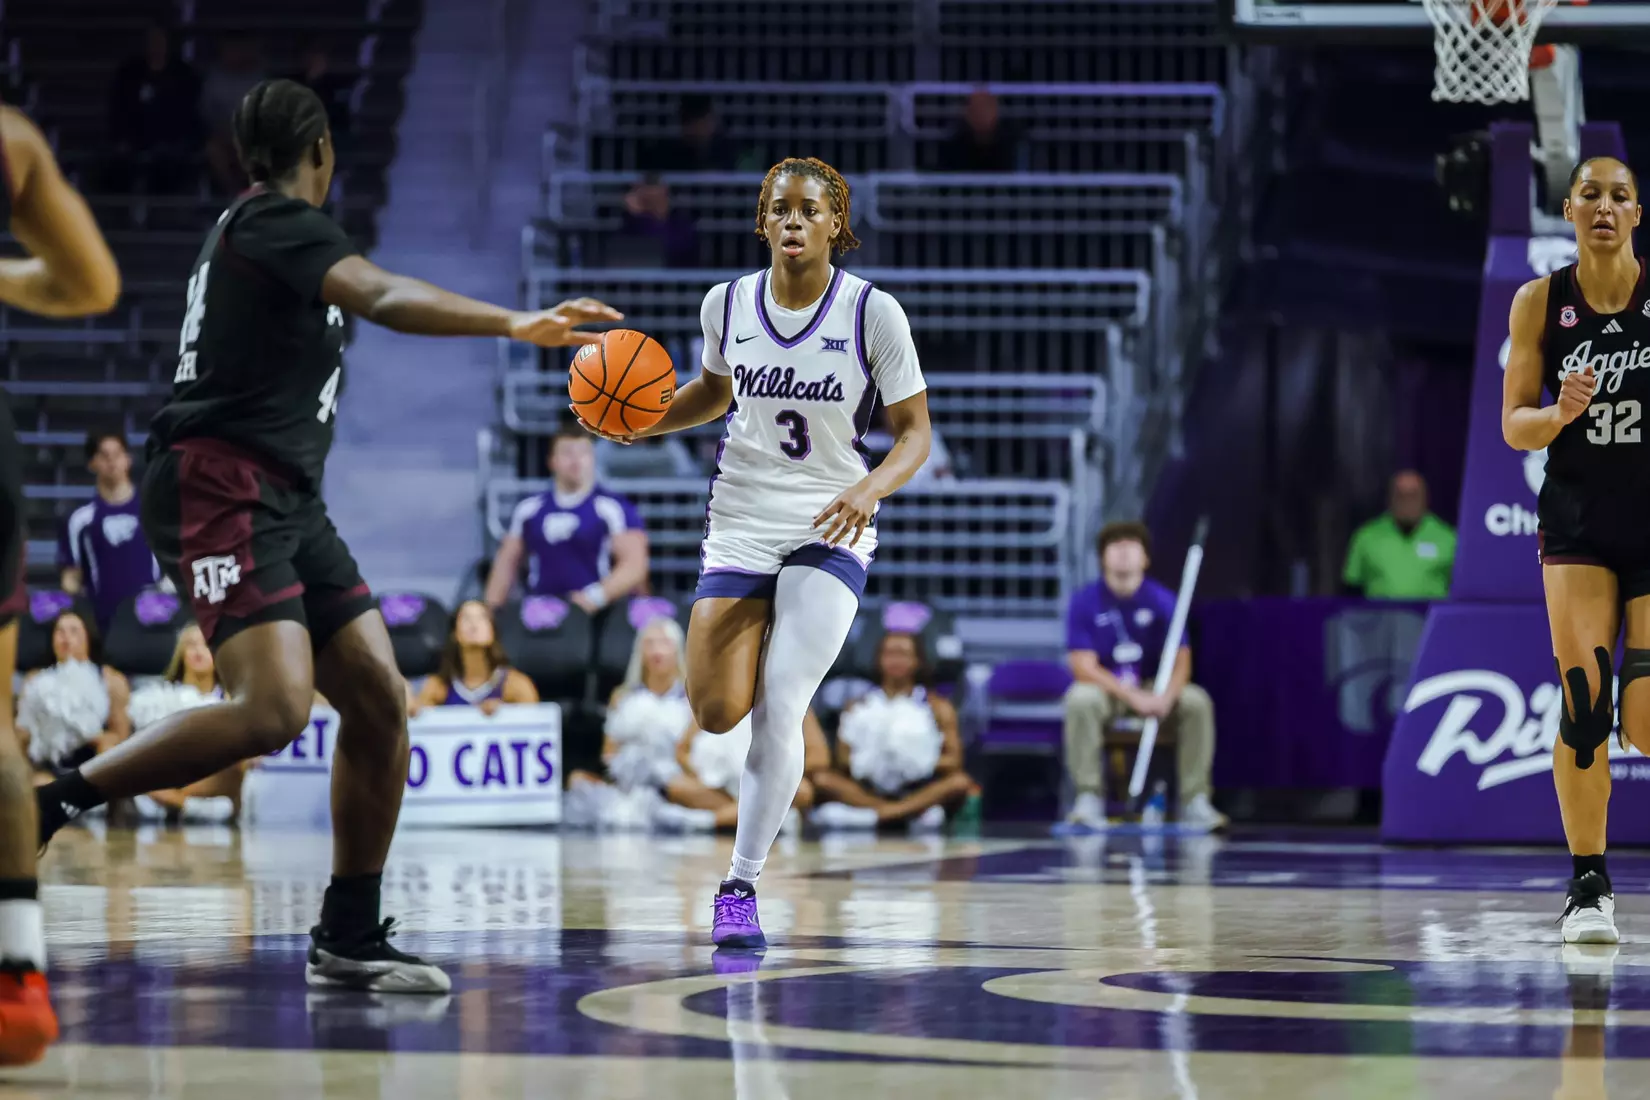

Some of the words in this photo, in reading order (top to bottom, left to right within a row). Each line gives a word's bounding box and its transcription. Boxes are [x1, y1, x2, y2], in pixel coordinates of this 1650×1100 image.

[820, 335, 850, 355] XII
[733, 363, 845, 402] Wildcats
[775, 409, 812, 461] 3
[1586, 399, 1642, 445] 32
[267, 719, 330, 759] ET
[453, 740, 555, 787] CATS
